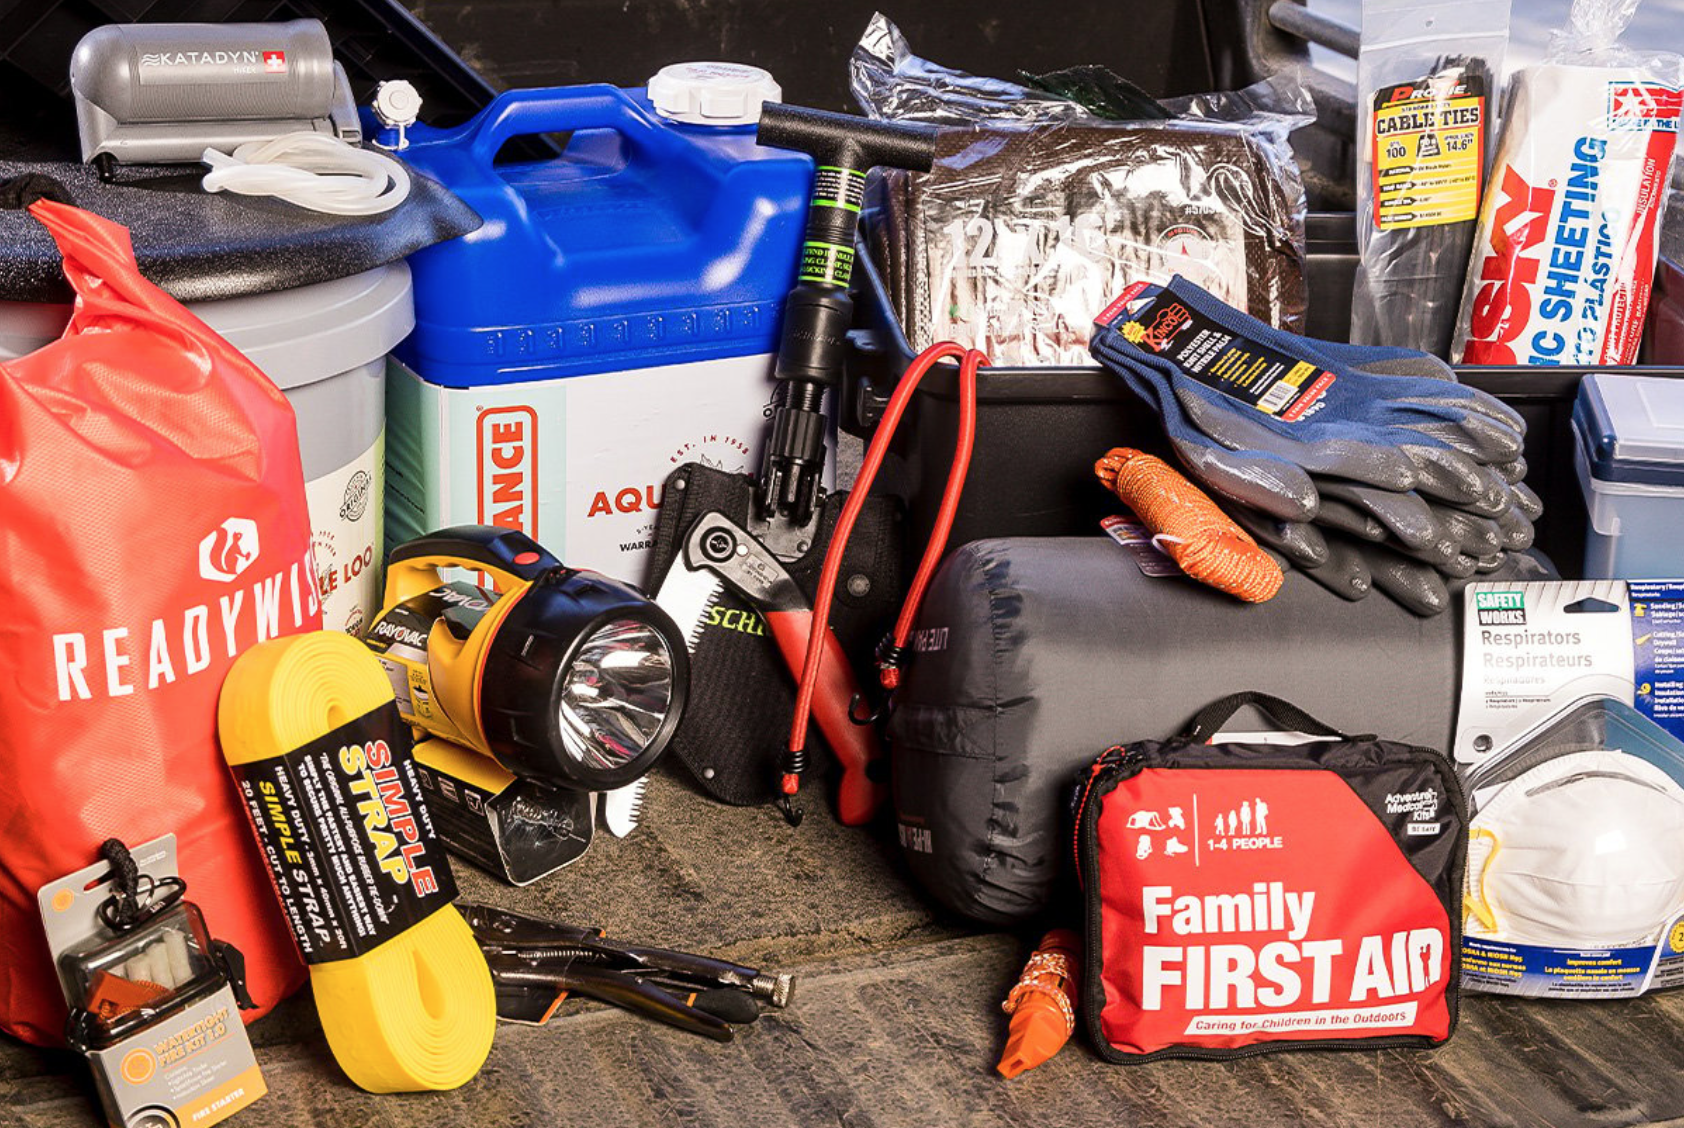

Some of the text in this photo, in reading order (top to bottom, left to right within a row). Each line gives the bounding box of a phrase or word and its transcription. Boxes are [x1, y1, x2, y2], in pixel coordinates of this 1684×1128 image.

[160, 51, 257, 65] KATADYN
[1377, 107, 1480, 134] CABLE TIES
[1386, 146, 1407, 159] 100
[1446, 139, 1473, 152] 14.6"
[1538, 136, 1609, 322] SHEETING
[1145, 315, 1180, 351] KINCO
[1178, 328, 1211, 362] POLYESTER
[1196, 334, 1218, 356] SHELL
[1214, 333, 1233, 353] PALM
[670, 443, 697, 465] EST.
[344, 545, 374, 585] LOO
[1477, 593, 1523, 608] SAFETY
[1480, 610, 1525, 624] WORKS
[374, 621, 428, 647] RAYOVAC
[1481, 629, 1582, 649] Respirators
[1483, 652, 1593, 671] Respirateurs
[294, 763, 308, 780] TO
[238, 778, 255, 800] 20
[299, 778, 324, 818] SECURE
[399, 759, 437, 841] HEAVY DUTY
[245, 798, 268, 836] FEET
[337, 743, 410, 885] STRAP
[363, 738, 439, 899] SIMPLE
[1387, 801, 1423, 814] Medical
[271, 764, 299, 810] HEAVY
[288, 808, 312, 845] DUTY
[303, 849, 322, 878] 3mm
[315, 884, 338, 920] 40mm
[302, 754, 377, 938] SIMPLY THE FASTEST AND EASIEST WAY
[314, 816, 338, 856] PRETTY
[1207, 836, 1284, 851] 1-4 PEOPLE
[258, 780, 331, 947] SIMPLE STRAP
[262, 843, 284, 878] CUT
[328, 853, 349, 886] MUCH
[274, 874, 291, 898] TO
[285, 897, 313, 953] LENGTH
[1142, 881, 1316, 941] Family
[1142, 927, 1444, 1011] FIRST AID
[1196, 1009, 1407, 1032] Caring for Children in the Outdoors
[157, 1043, 186, 1067] FIRE
[184, 1033, 206, 1053] KIT
[210, 1088, 244, 1111] STARTER
